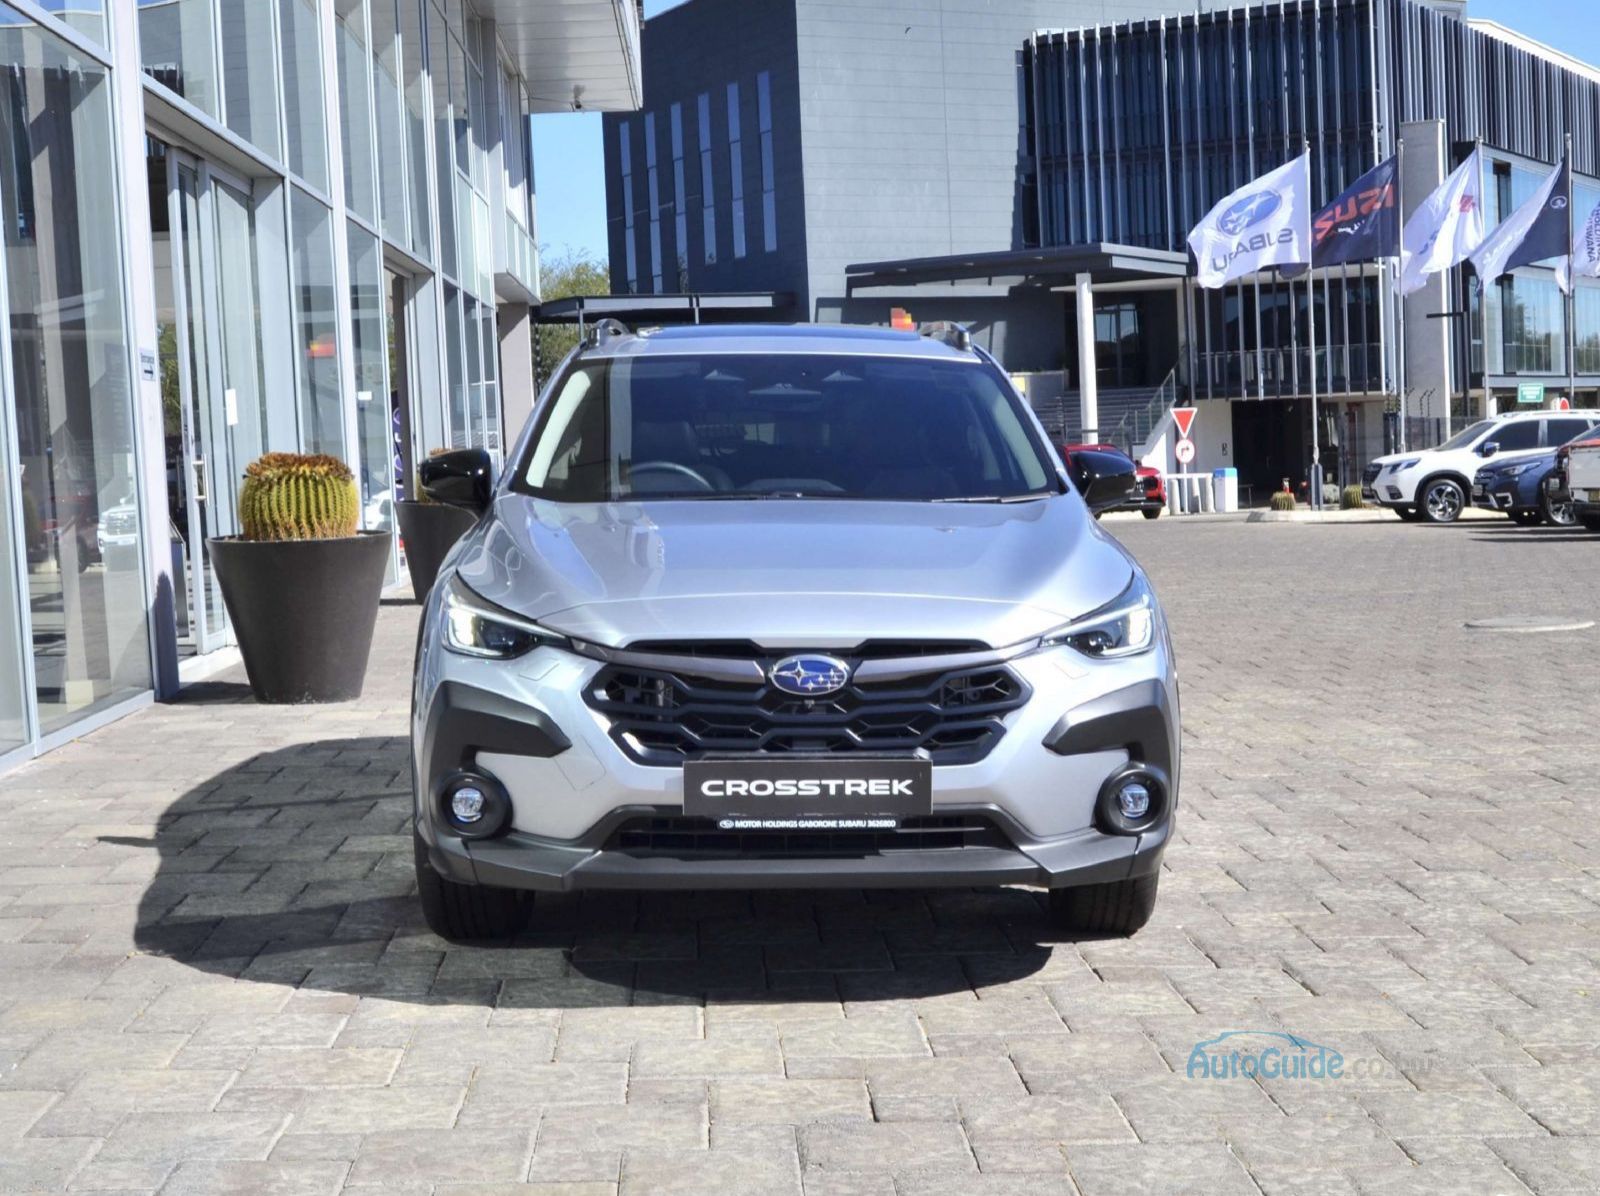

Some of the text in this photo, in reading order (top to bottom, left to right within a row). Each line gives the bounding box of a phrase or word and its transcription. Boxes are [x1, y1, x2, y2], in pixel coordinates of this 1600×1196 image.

[700, 779, 914, 796] CROSSTREK
[735, 819, 762, 829] MOTOR
[762, 819, 798, 829] HOLDINGS
[798, 819, 838, 829] GABORONE
[838, 819, 867, 829] SUBARU
